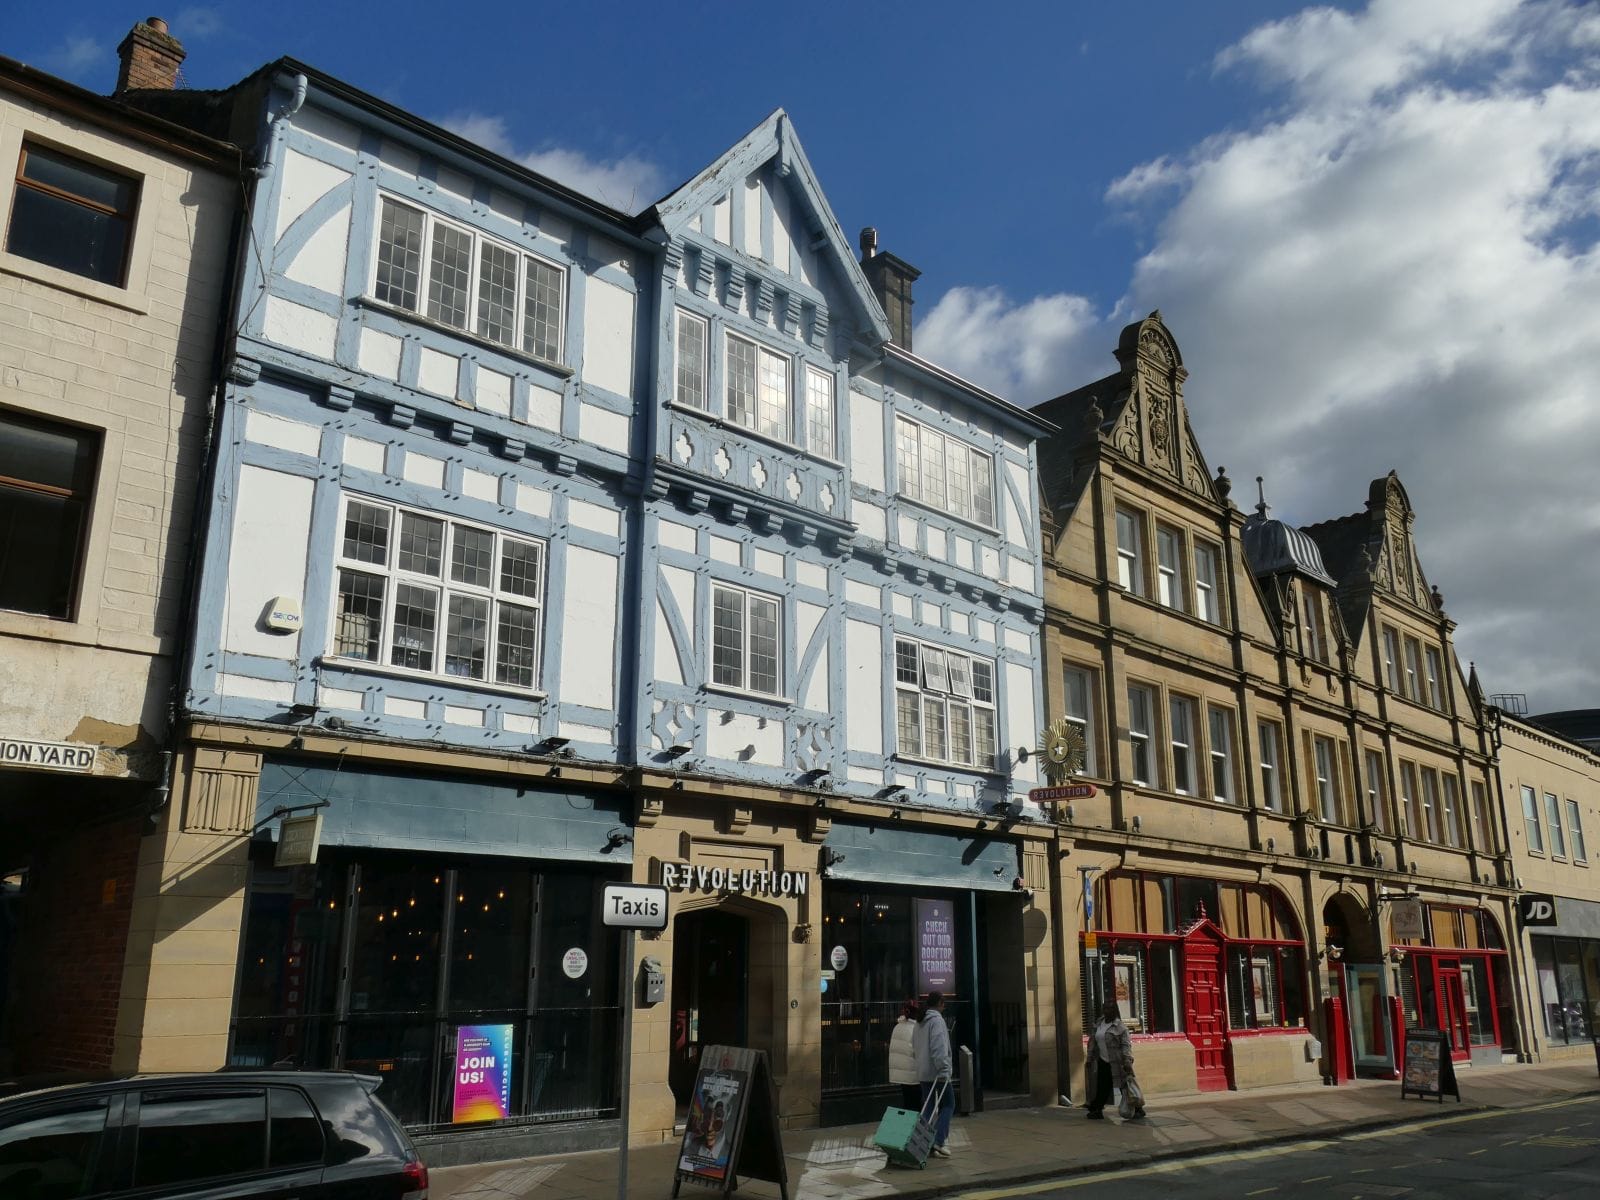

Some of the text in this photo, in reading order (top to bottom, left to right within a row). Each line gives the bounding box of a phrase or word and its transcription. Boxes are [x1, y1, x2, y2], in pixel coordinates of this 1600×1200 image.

[38, 745, 91, 767] YARD
[1033, 786, 1087, 800] REVOLUTION
[662, 863, 806, 895] REVOLUTION
[611, 895, 659, 917] Taxis
[1526, 901, 1553, 920] JD
[925, 920, 947, 933] CHECK
[922, 933, 951, 947] OUT OUR
[921, 947, 952, 960] ROOFTOP
[921, 960, 953, 973] TERRACE
[460, 1056, 495, 1070] JOIN
[460, 1071, 484, 1085] US!
